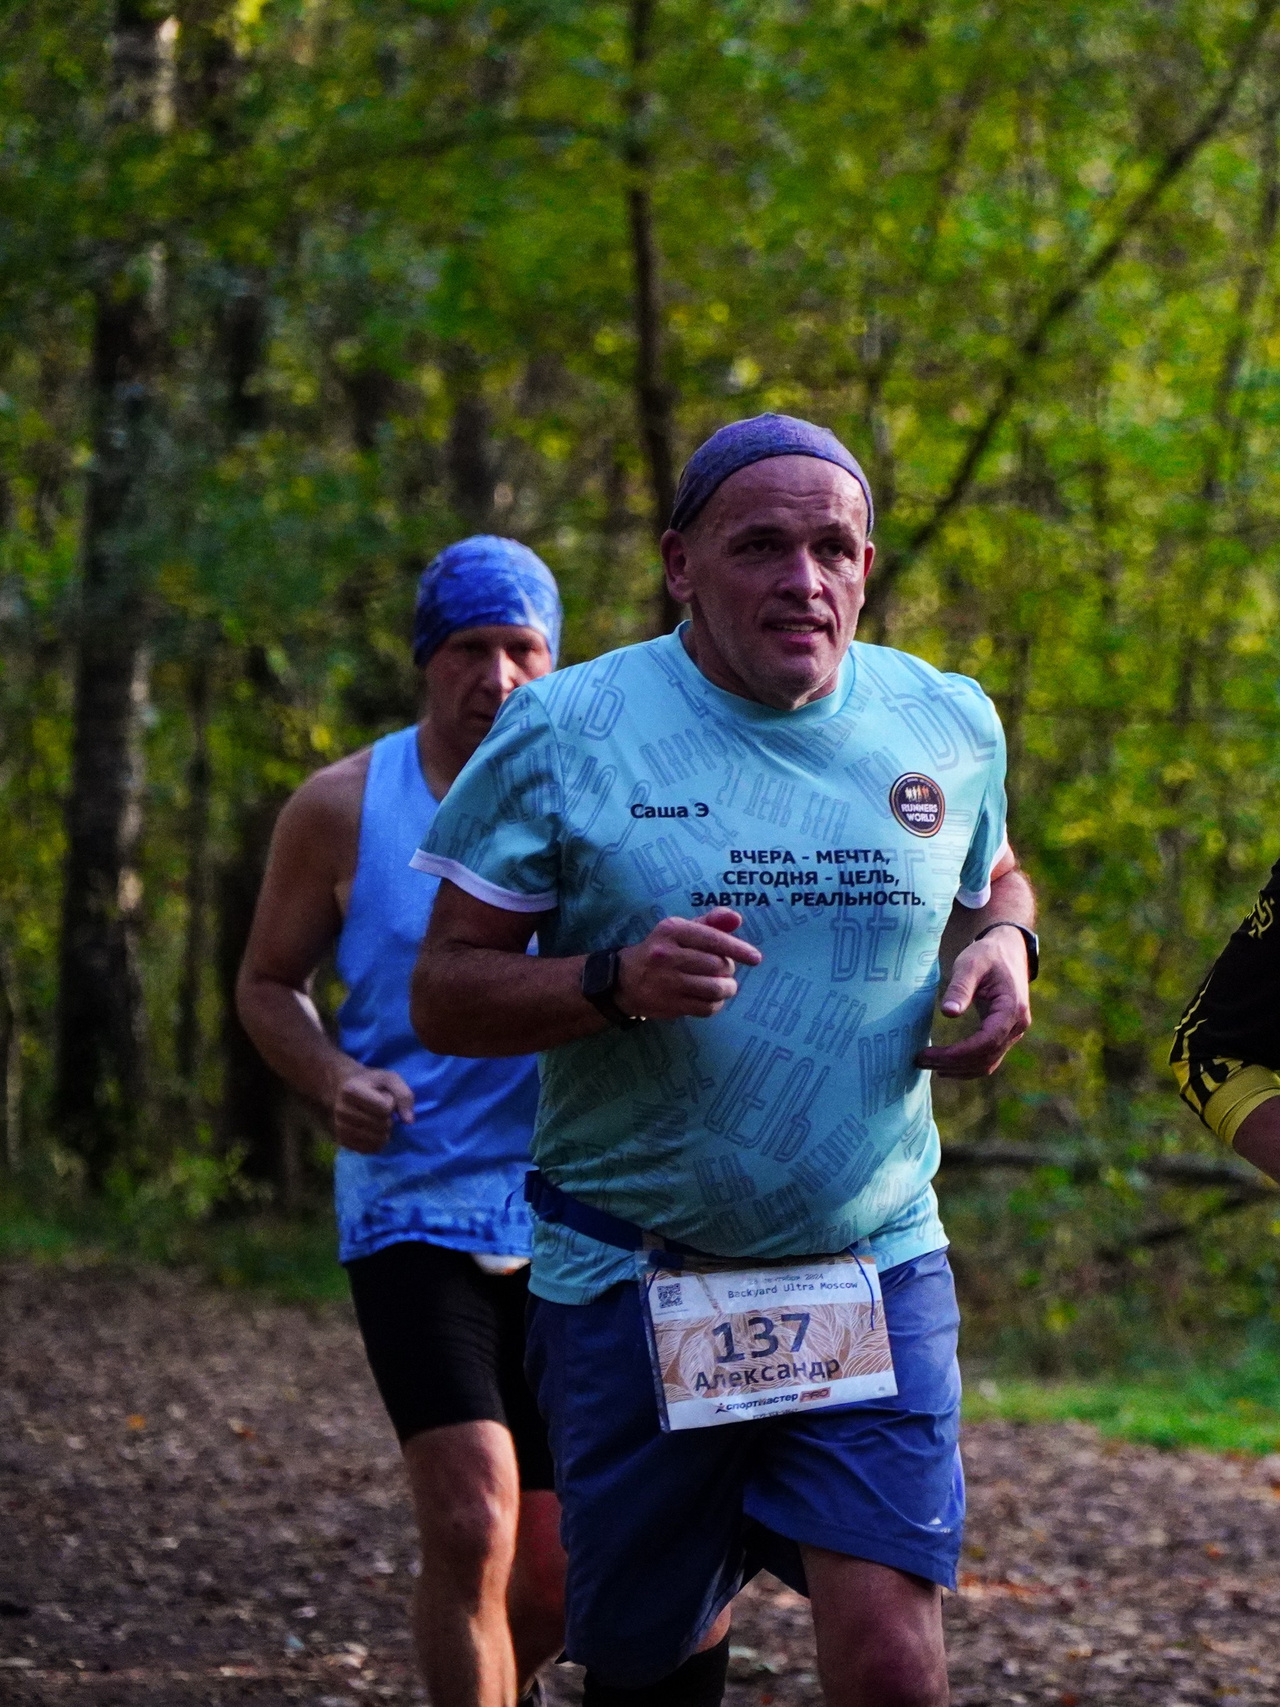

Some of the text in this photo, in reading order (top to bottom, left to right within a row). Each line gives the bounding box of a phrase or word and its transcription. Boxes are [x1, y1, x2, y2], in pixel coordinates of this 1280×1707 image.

[630, 802, 710, 819] Саша Э
[901, 803, 938, 813] RUNNERS
[906, 813, 936, 823] WORLD
[730, 849, 797, 864] ВЧЕРА
[815, 849, 891, 866] МЕЧТА,
[722, 870, 819, 888] СЕГОДНЯ
[839, 869, 901, 888] ЦЕЛЬ,
[690, 891, 771, 908] ЗАВТРА
[790, 890, 926, 907] РЕАЛЬНОСТЬ.
[704, 1034, 832, 1163] ЦЕЛЬ
[727, 1281, 858, 1299] Backyard Ultra Moscow
[712, 1312, 811, 1364] 137
[695, 1358, 841, 1391] Александр
[800, 1388, 831, 1402] PRO
